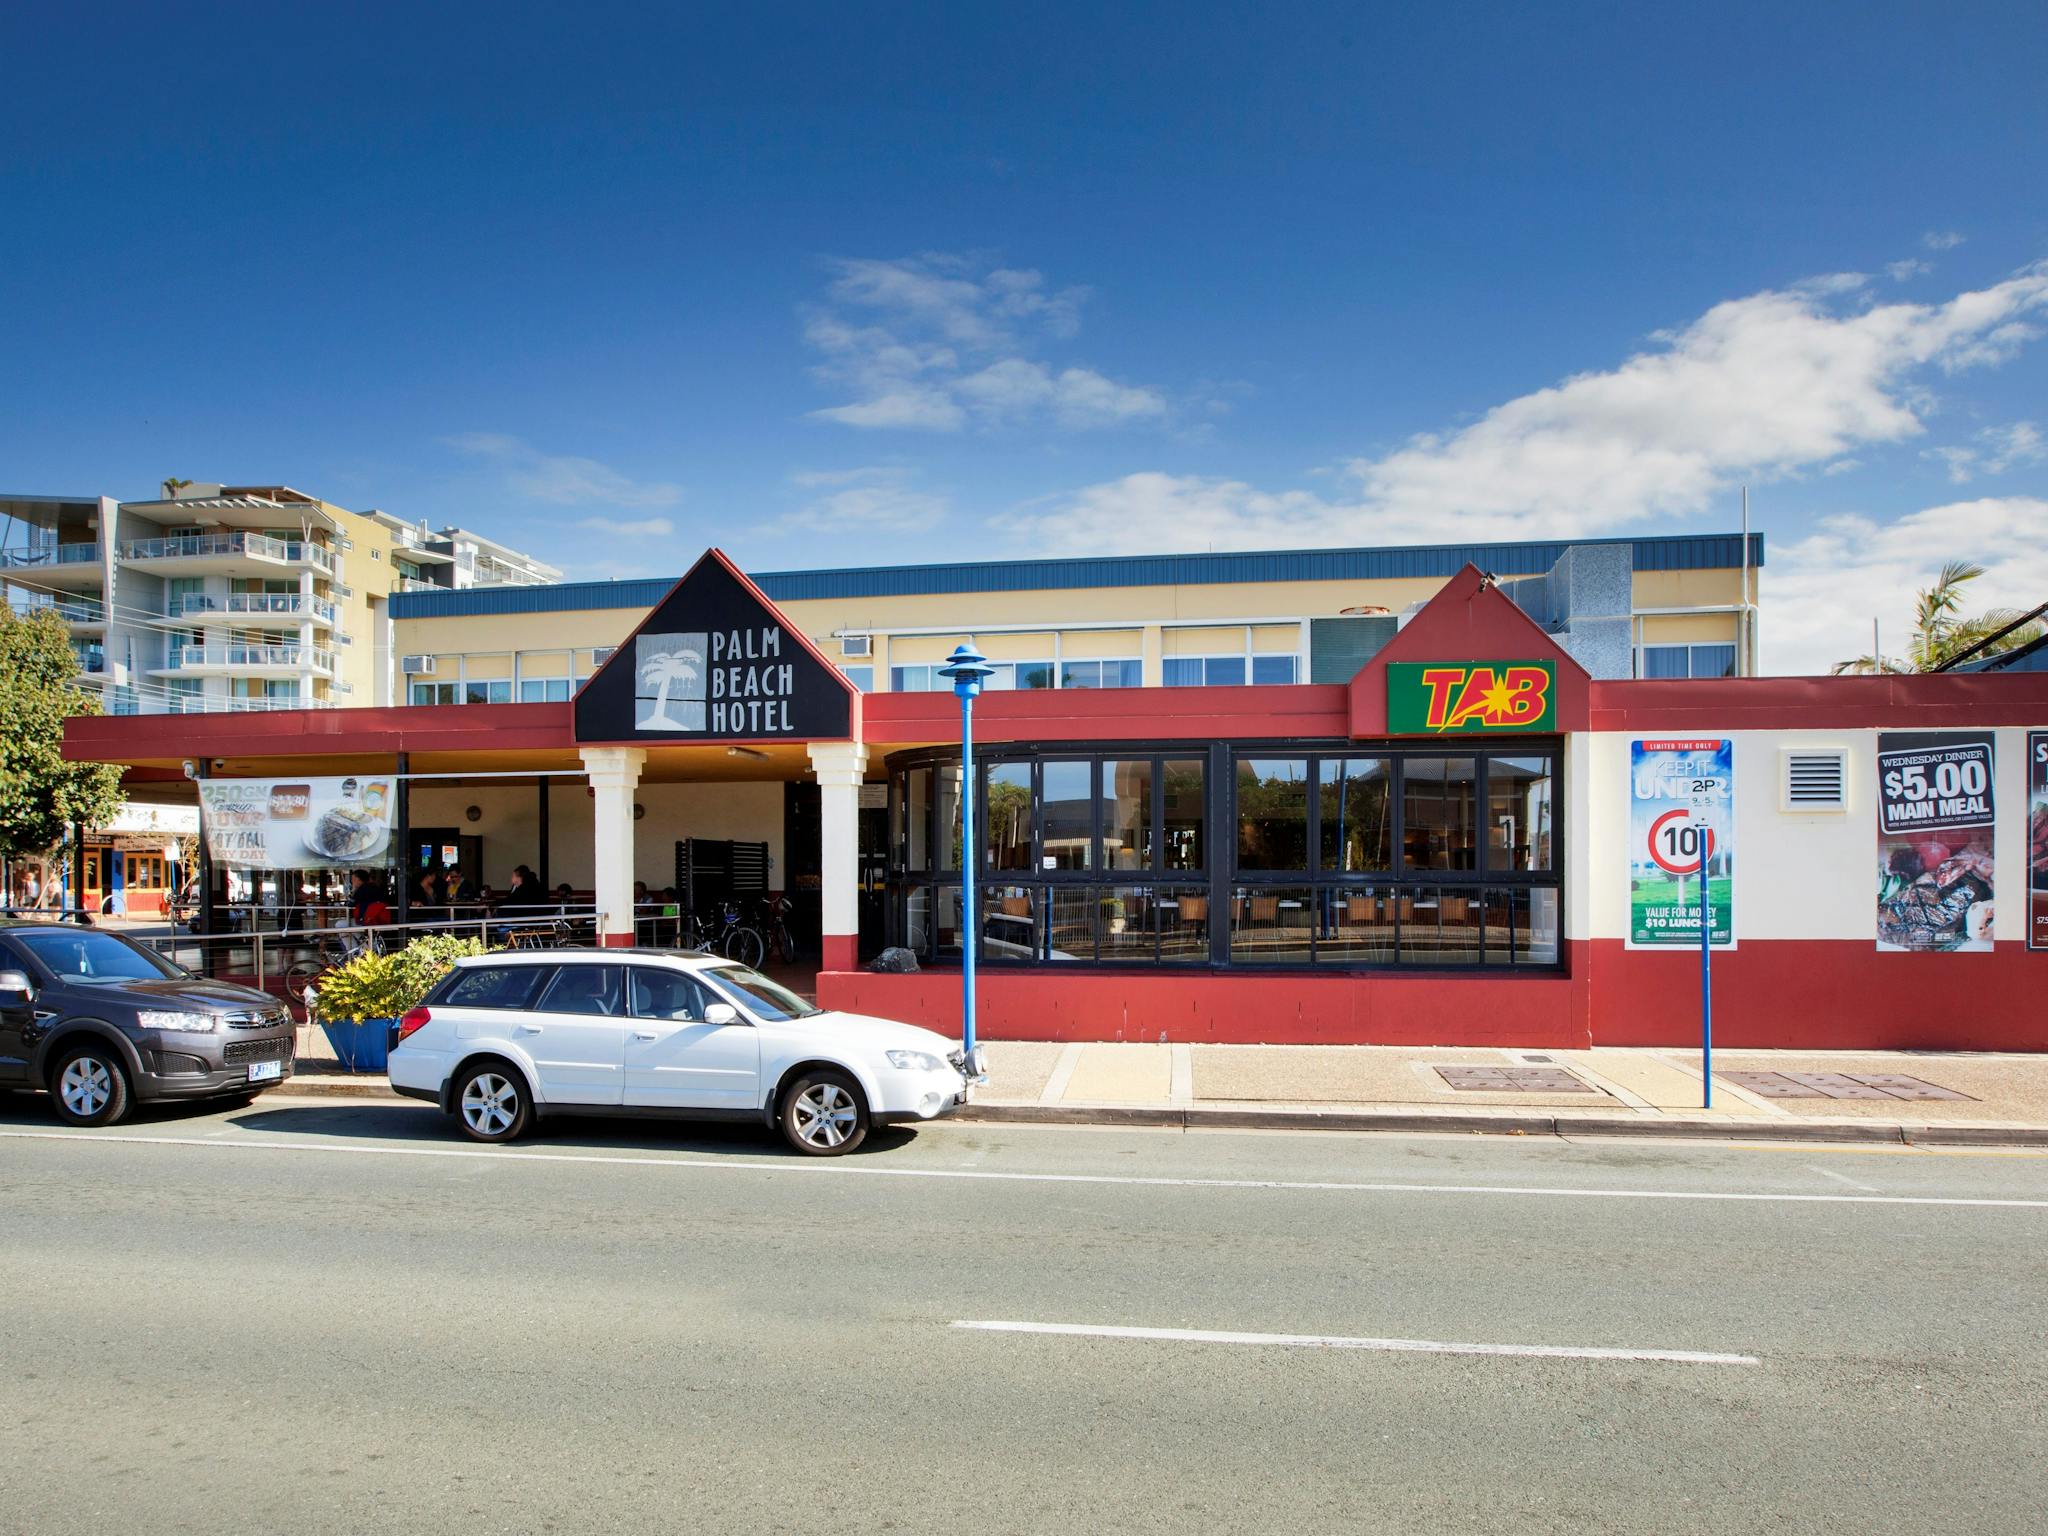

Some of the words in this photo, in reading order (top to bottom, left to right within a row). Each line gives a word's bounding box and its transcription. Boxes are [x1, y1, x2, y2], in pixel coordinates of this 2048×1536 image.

[712, 626, 780, 661] PALM
[712, 664, 793, 698] BEACH
[1422, 667, 1549, 728] TAB
[712, 700, 794, 733] HOTEL
[1656, 760, 1695, 777] KEEP
[1697, 760, 1712, 777] IT
[1882, 753, 1944, 768] WEDNESDAY
[1945, 750, 1984, 762] DINNER
[1884, 760, 1987, 801] $5.00
[1887, 800, 1935, 821] MAIN
[1938, 796, 1990, 817] MEAL
[1664, 826, 1699, 856] 10
[1645, 907, 1670, 918] VALUE
[1671, 907, 1686, 918] FOR
[1688, 907, 1717, 918] MOEY
[1645, 918, 1667, 929] $10
